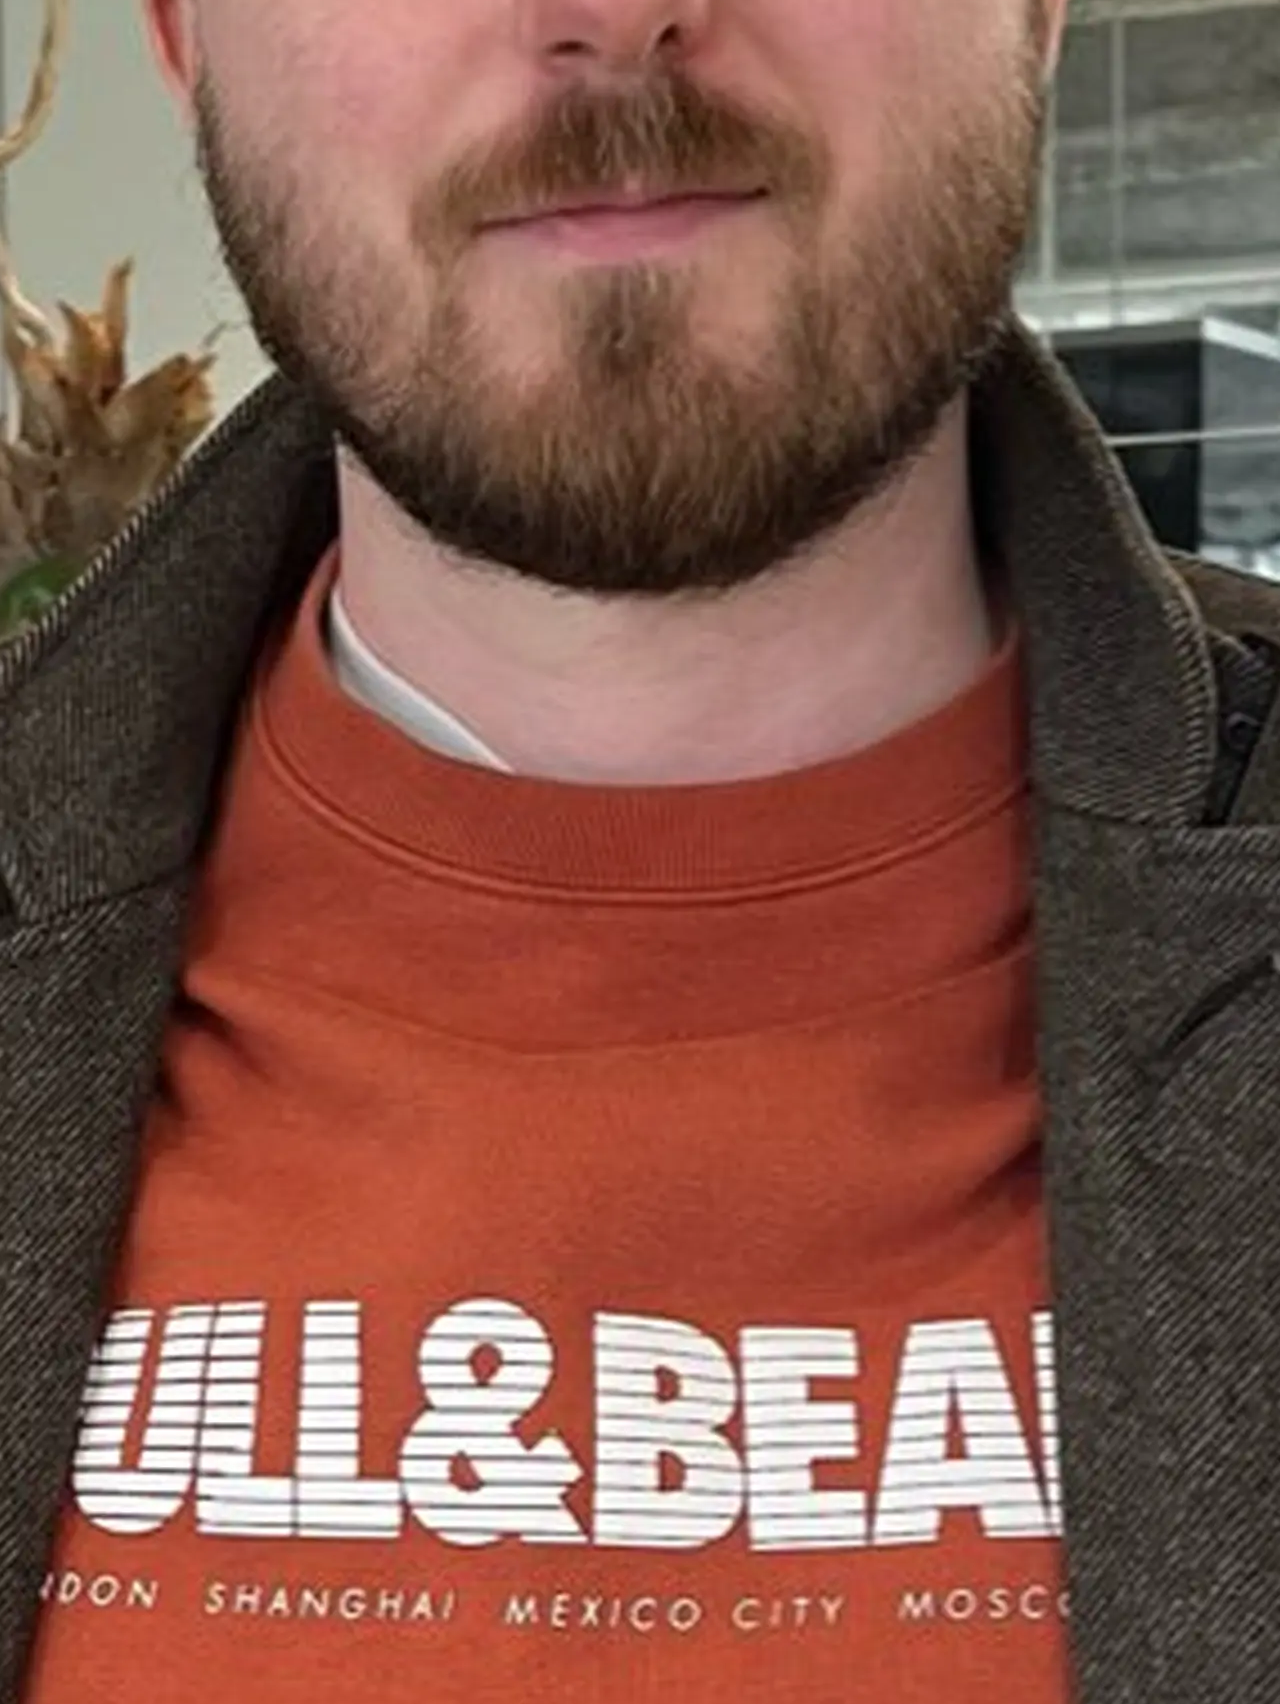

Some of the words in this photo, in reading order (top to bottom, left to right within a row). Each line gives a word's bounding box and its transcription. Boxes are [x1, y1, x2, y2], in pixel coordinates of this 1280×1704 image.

[72, 1298, 1065, 1552] ULL&BEA
[205, 1582, 453, 1620] SHANGHAI
[505, 1594, 702, 1631] MEXICO
[731, 1597, 844, 1629] CITY
